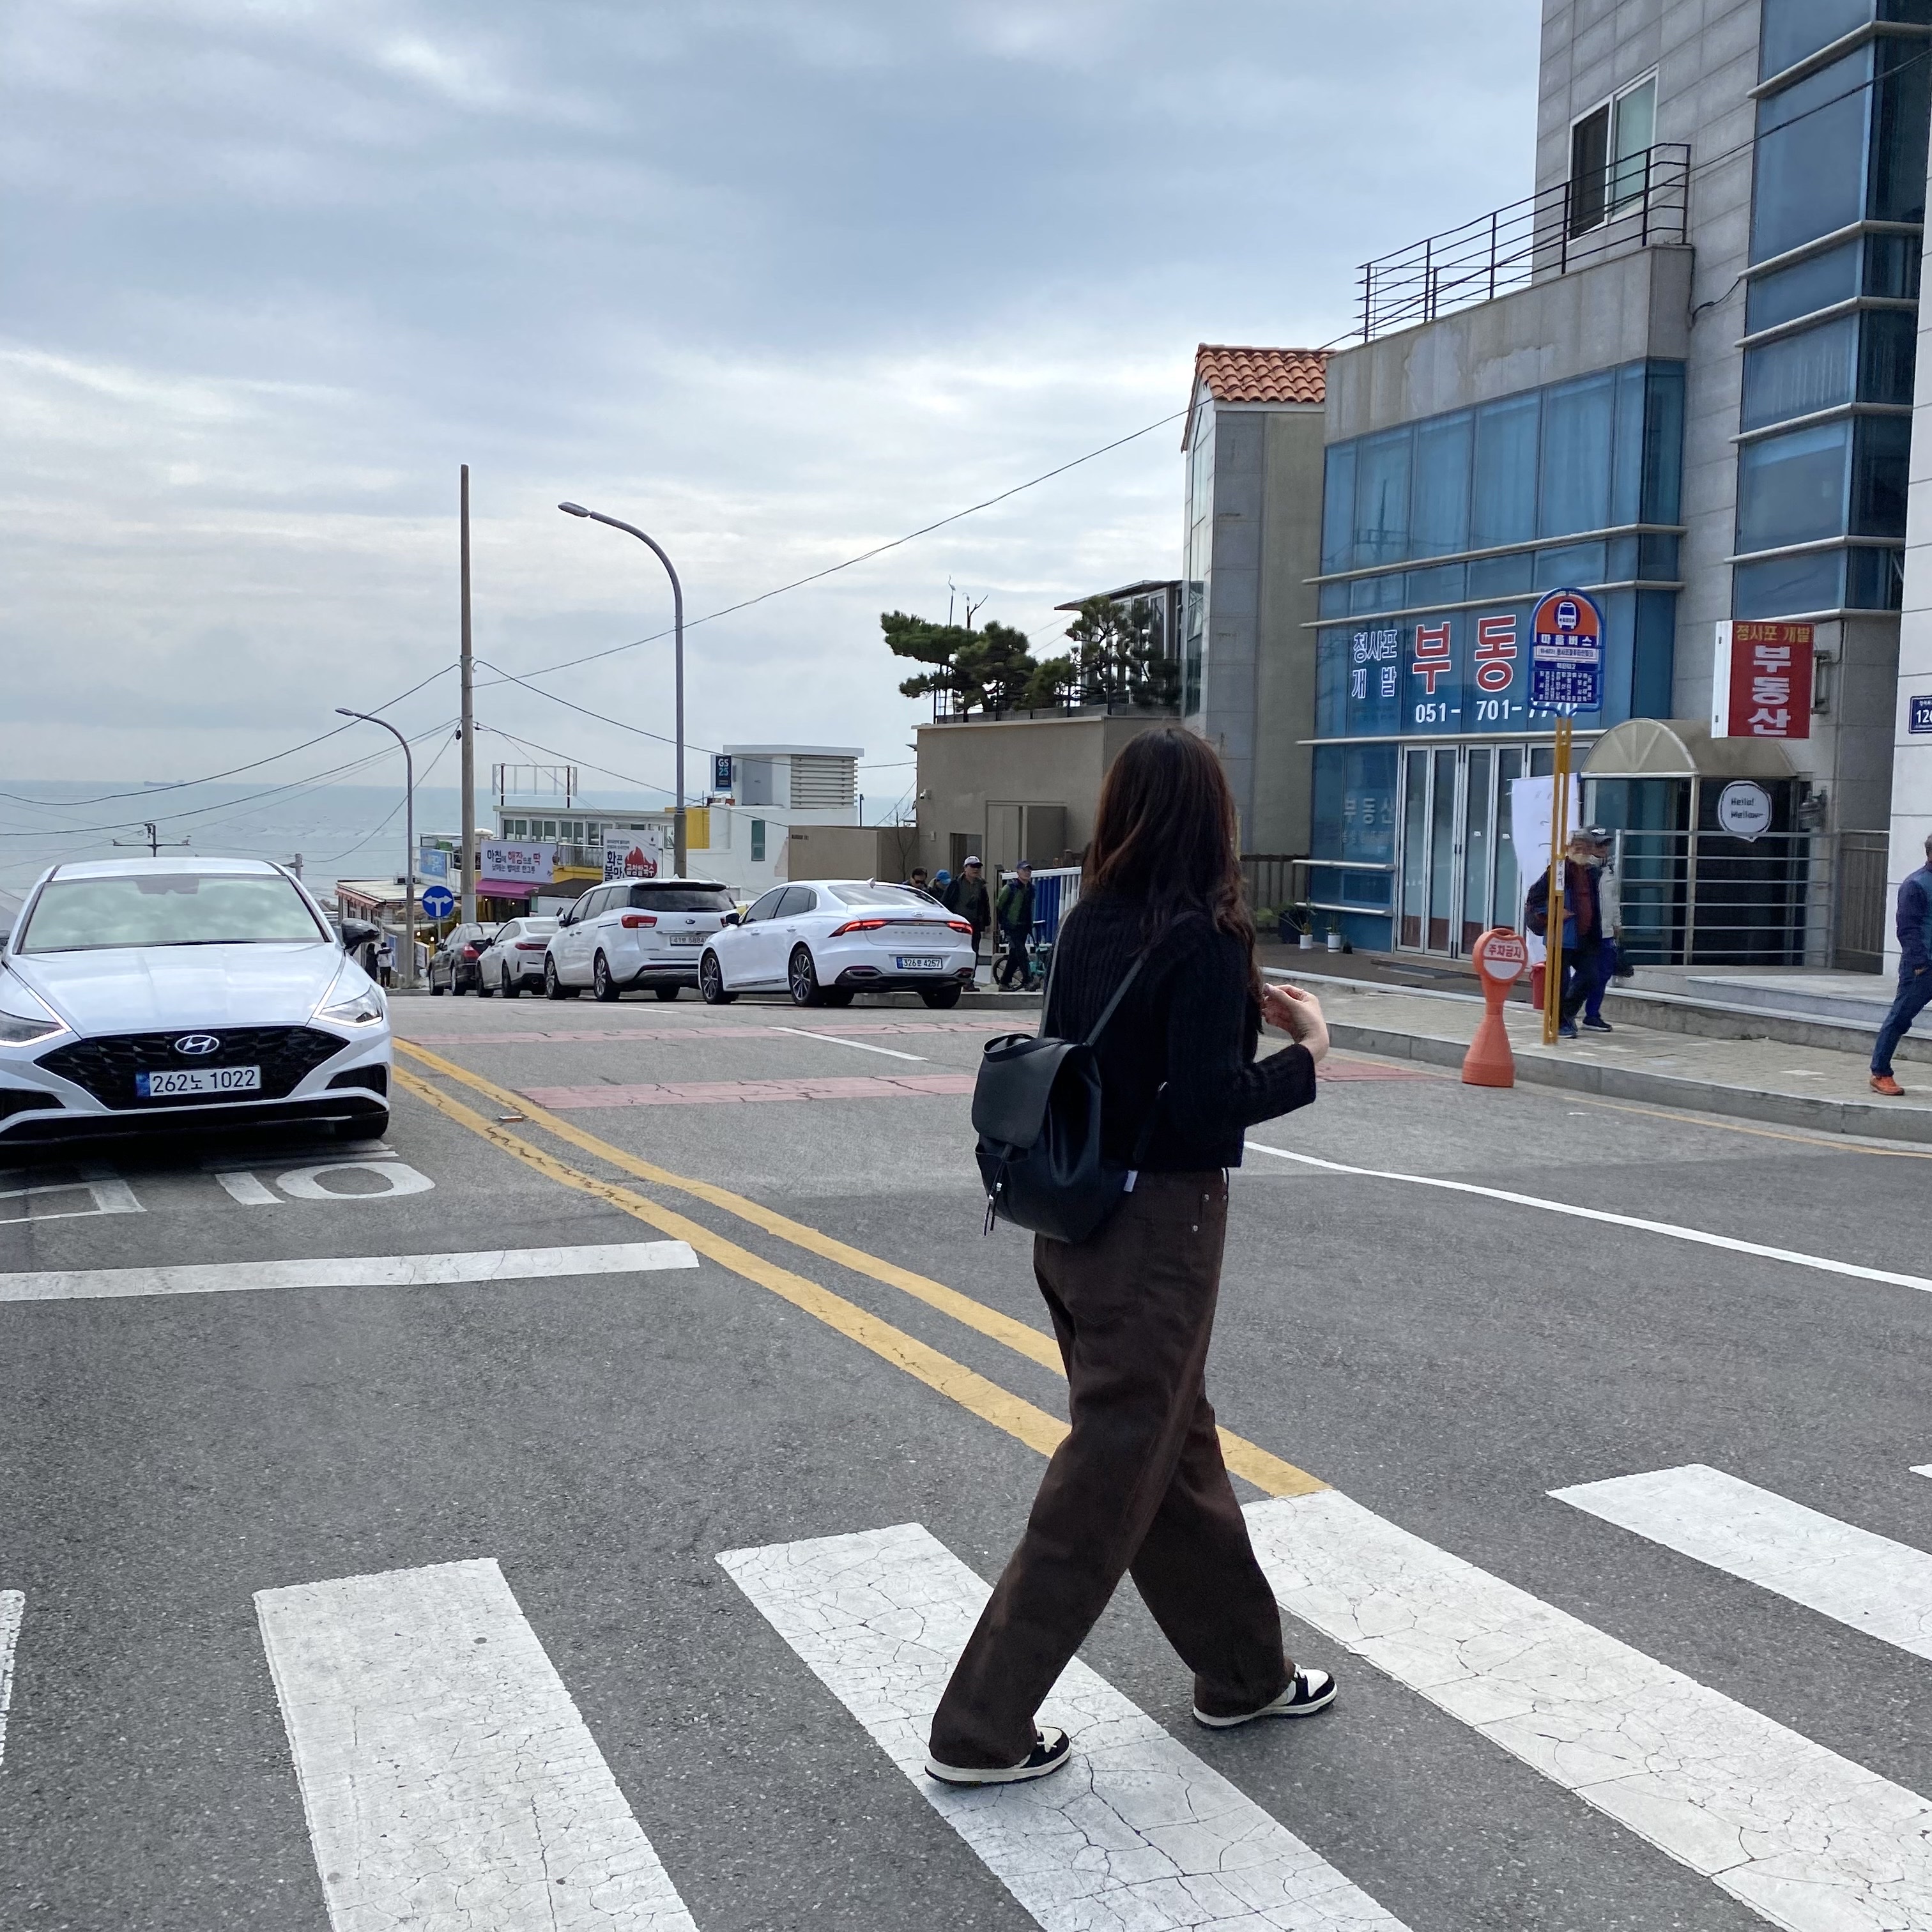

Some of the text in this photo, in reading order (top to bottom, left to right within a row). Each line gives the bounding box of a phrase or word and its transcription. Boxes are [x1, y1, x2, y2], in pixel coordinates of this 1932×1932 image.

[1353, 629, 1397, 664] 청사포
[1747, 645, 1791, 735] 부동산
[718, 758, 729, 767] GS
[719, 767, 729, 776] 25
[1731, 797, 1754, 806] Hello!
[607, 851, 622, 866] 화끈
[1489, 944, 1521, 958] 주차금지
[923, 959, 940, 967] 4257
[153, 1069, 256, 1093] 262노 1022
